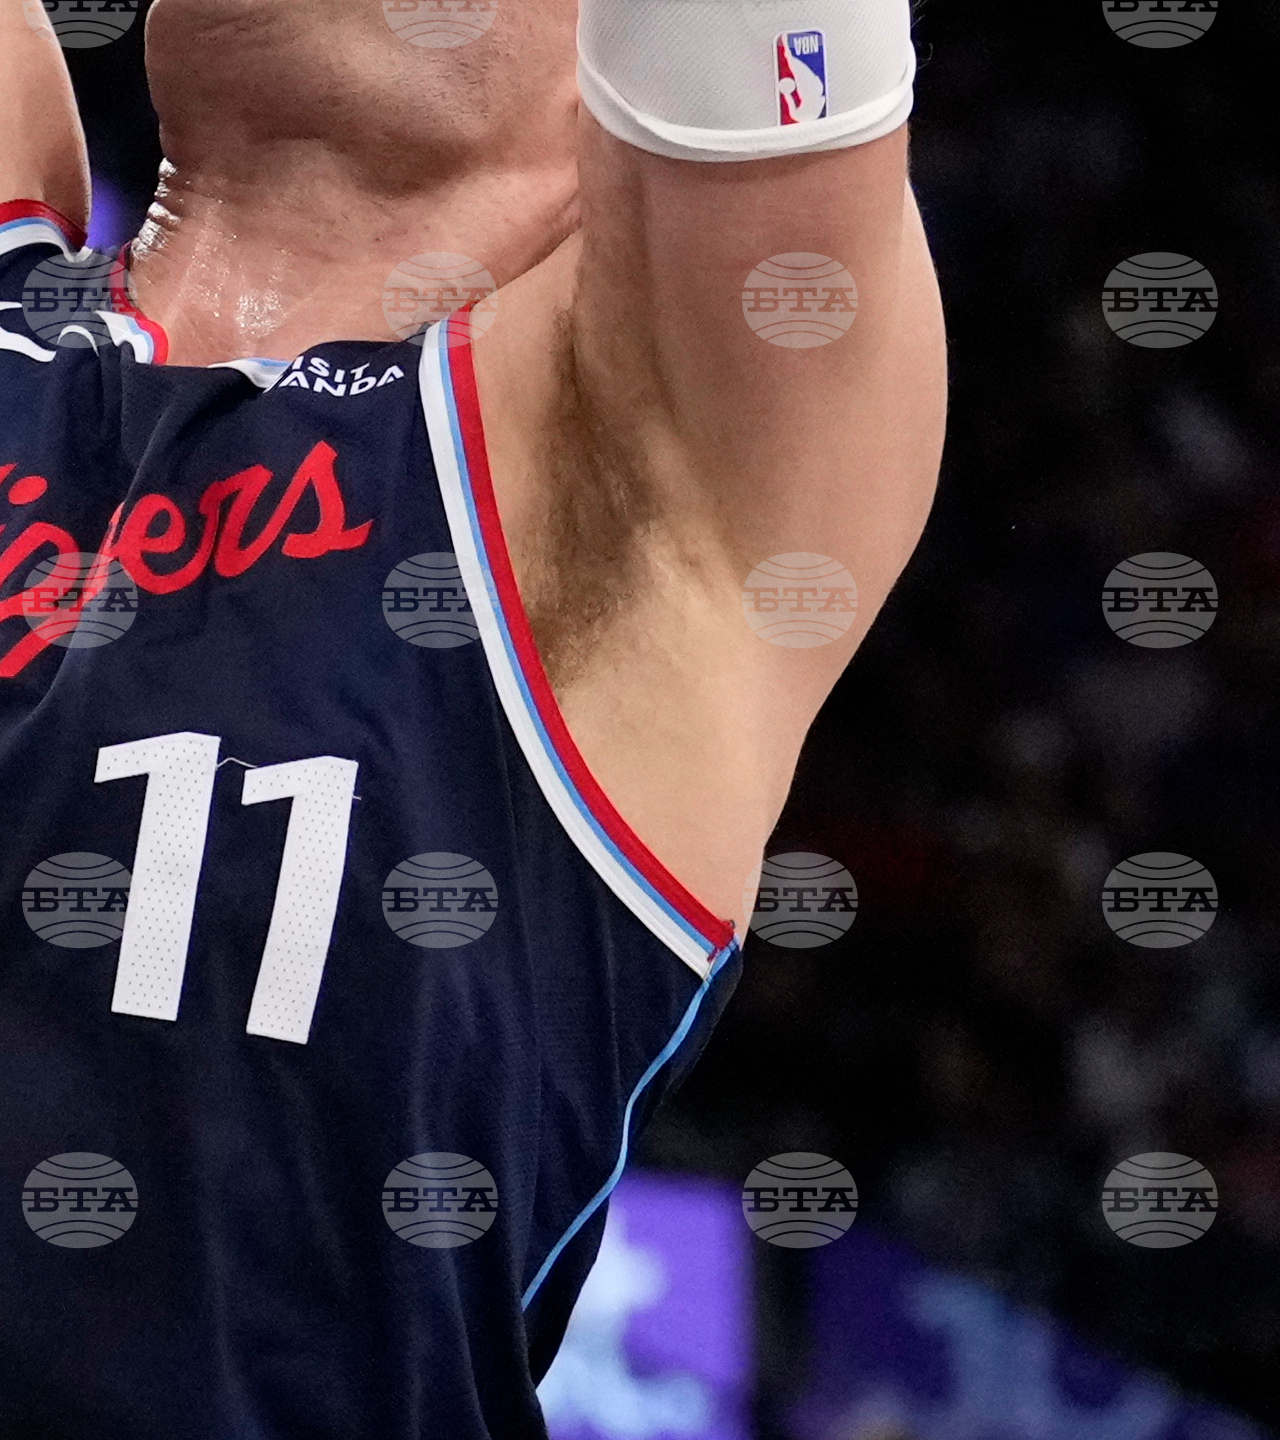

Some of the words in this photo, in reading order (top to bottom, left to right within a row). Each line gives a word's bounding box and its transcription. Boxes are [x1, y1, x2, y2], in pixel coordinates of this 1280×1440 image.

[793, 33, 819, 56] NBA
[277, 364, 405, 398] ANDA
[292, 355, 370, 384] ISIT
[94, 731, 361, 1045] 11
